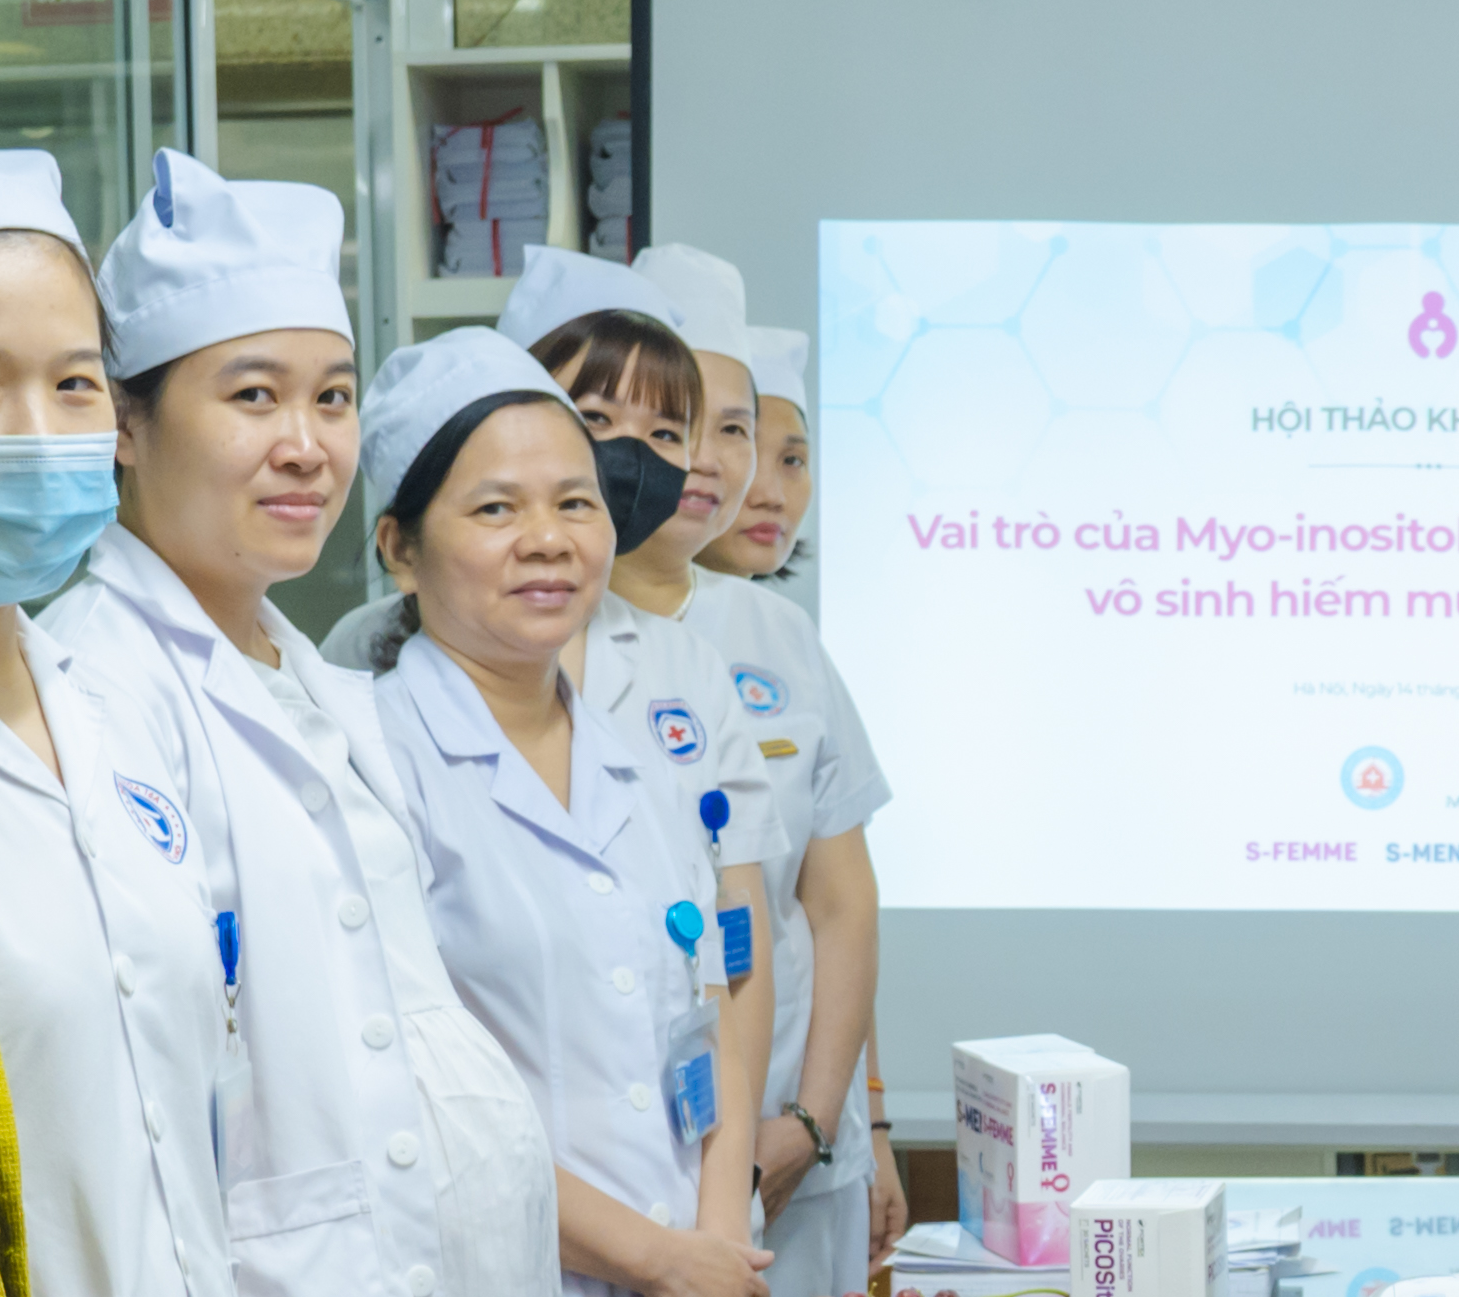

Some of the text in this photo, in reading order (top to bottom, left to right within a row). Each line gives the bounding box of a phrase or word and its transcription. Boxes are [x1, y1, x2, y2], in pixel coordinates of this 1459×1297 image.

[1251, 401, 1312, 439] HỘI
[1320, 397, 1417, 433] THẢO
[906, 509, 980, 551] Vai
[991, 510, 1061, 551] trò
[1073, 509, 1160, 552] của
[1085, 577, 1143, 617] vô
[1155, 577, 1255, 618] sinh
[1270, 574, 1391, 618] hiếm
[1293, 682, 1315, 696] Hà
[1245, 841, 1358, 862] S-FEMME
